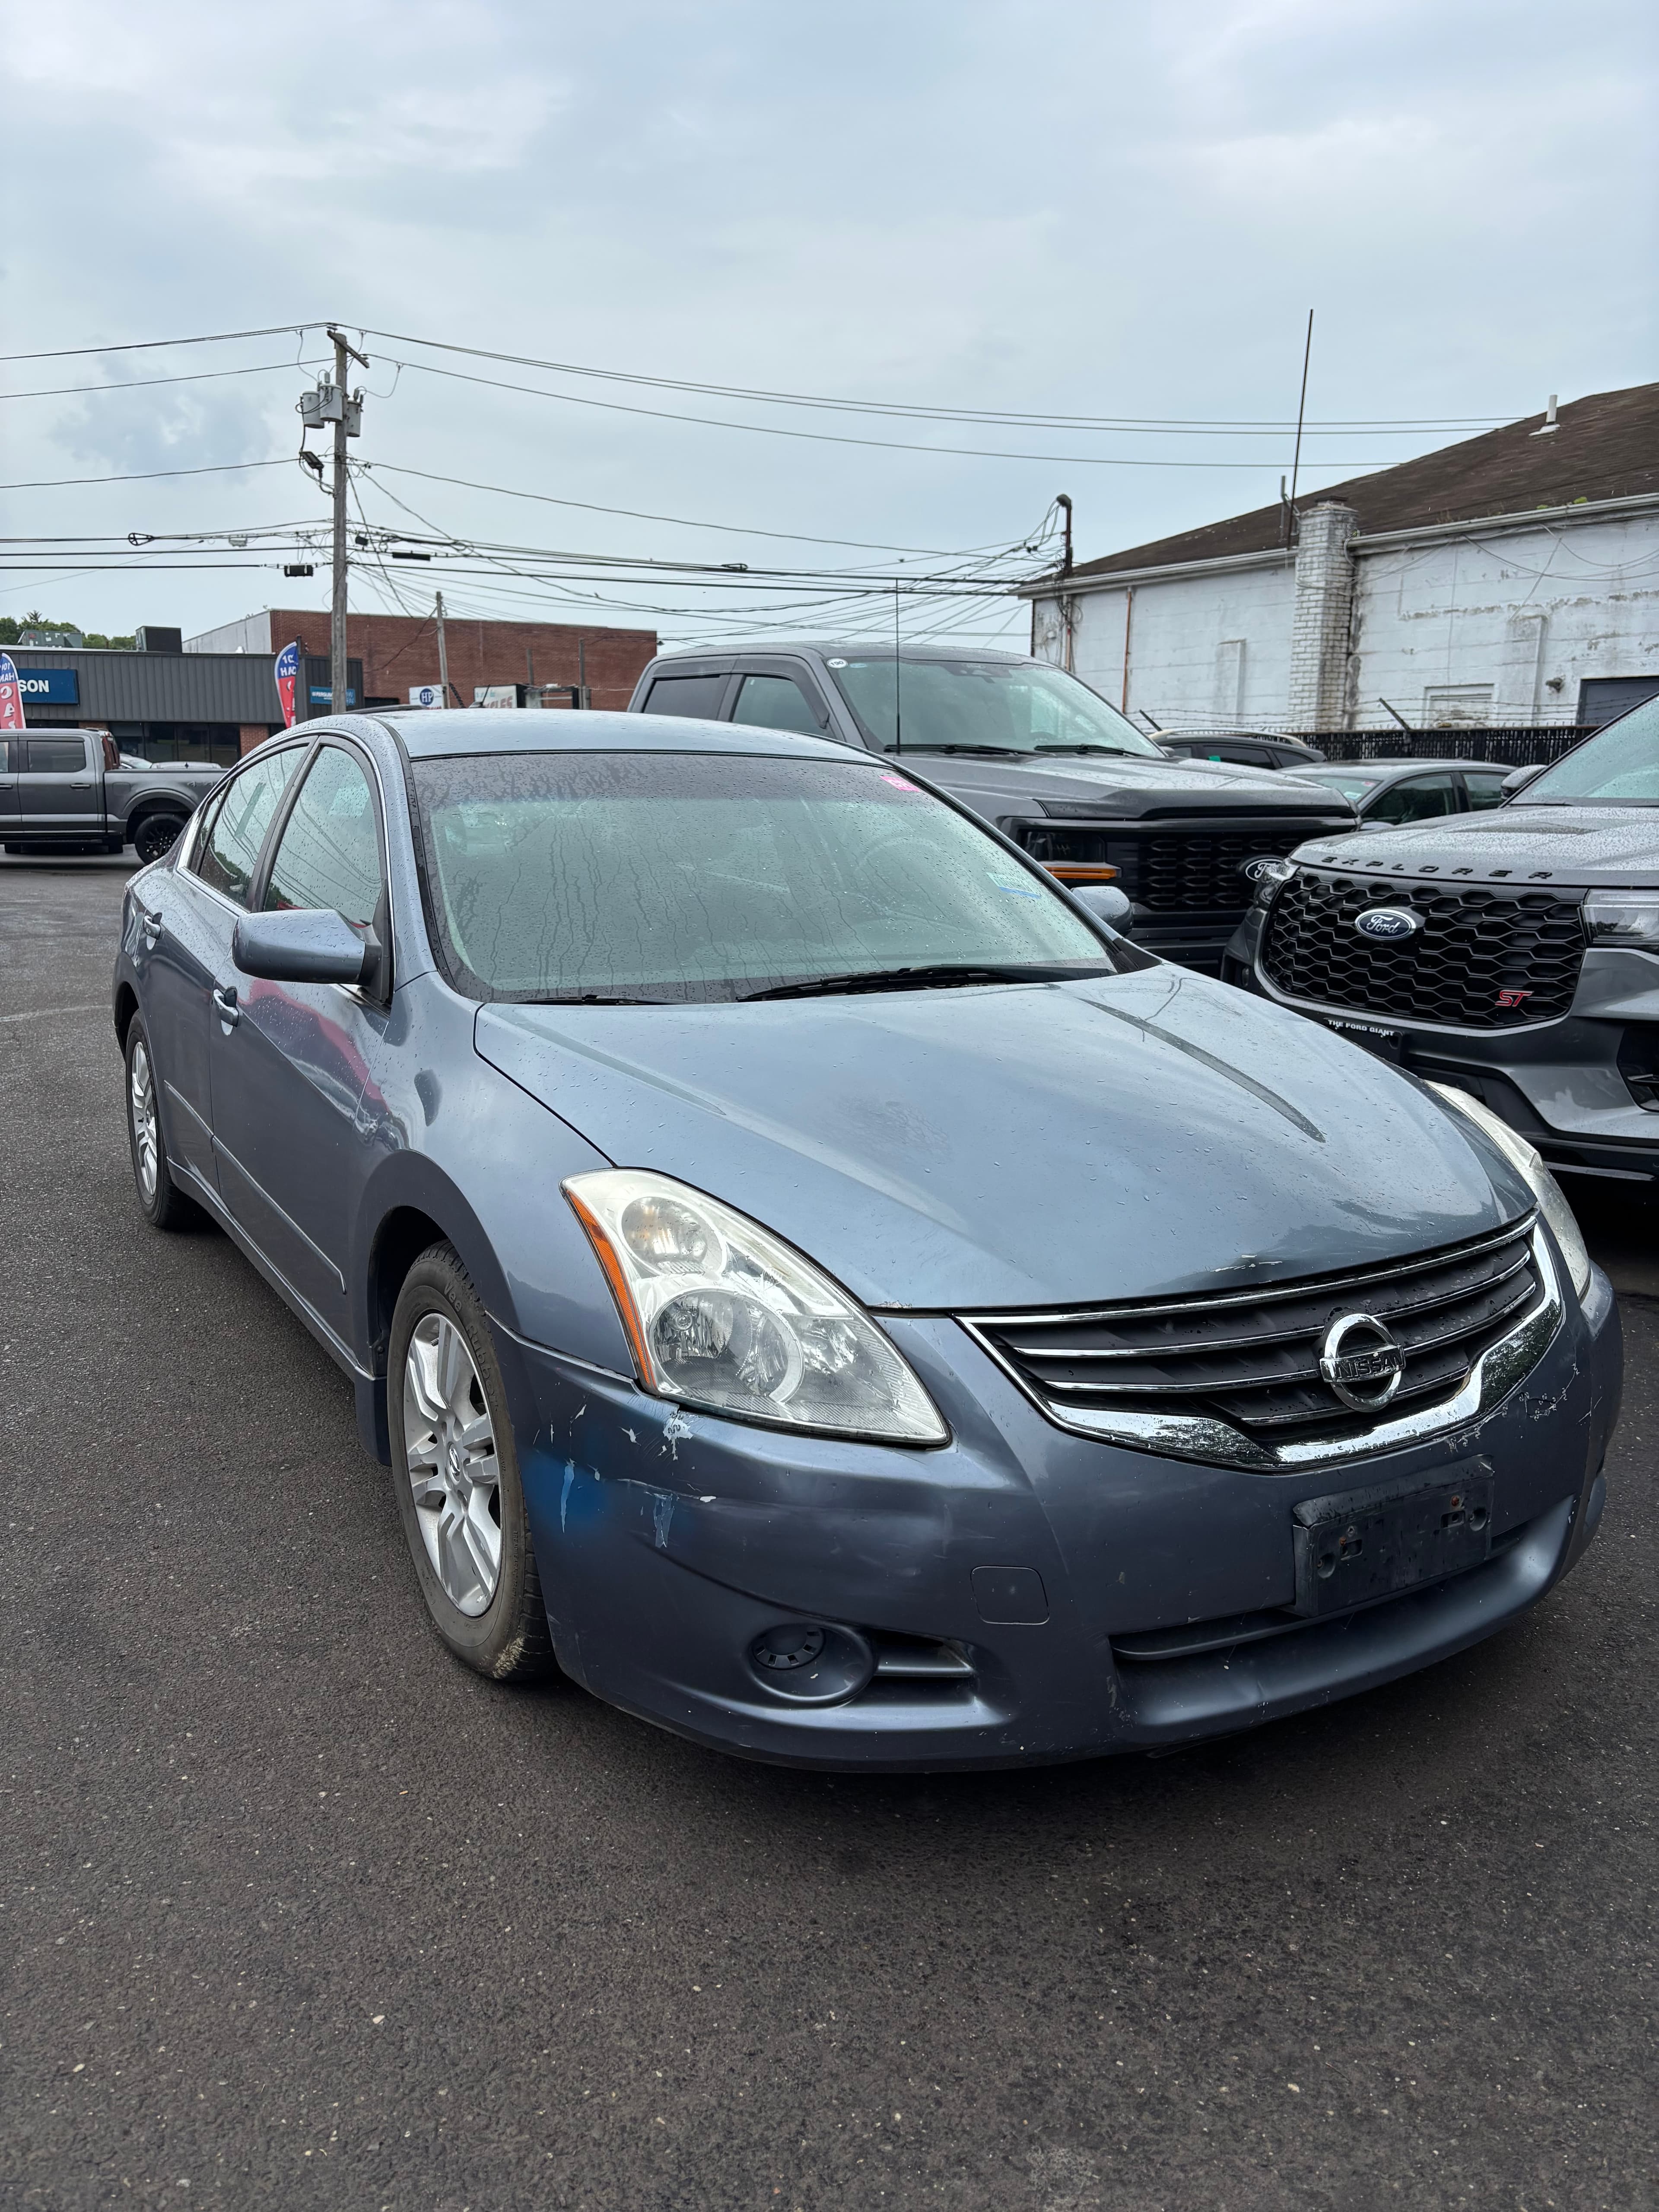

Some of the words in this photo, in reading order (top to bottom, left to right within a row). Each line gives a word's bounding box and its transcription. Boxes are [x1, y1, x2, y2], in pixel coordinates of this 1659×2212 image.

[421, 692, 434, 703] HP
[1321, 856, 1553, 879] EXPLORER
[1366, 915, 1401, 934] Ford
[1495, 989, 1535, 1007] ST
[1328, 1019, 1343, 1027] THE
[1345, 1022, 1368, 1031] FORD
[1369, 1027, 1395, 1036] GIANT
[444, 1282, 462, 1312] Vee
[1336, 1353, 1404, 1379] NISSAN
